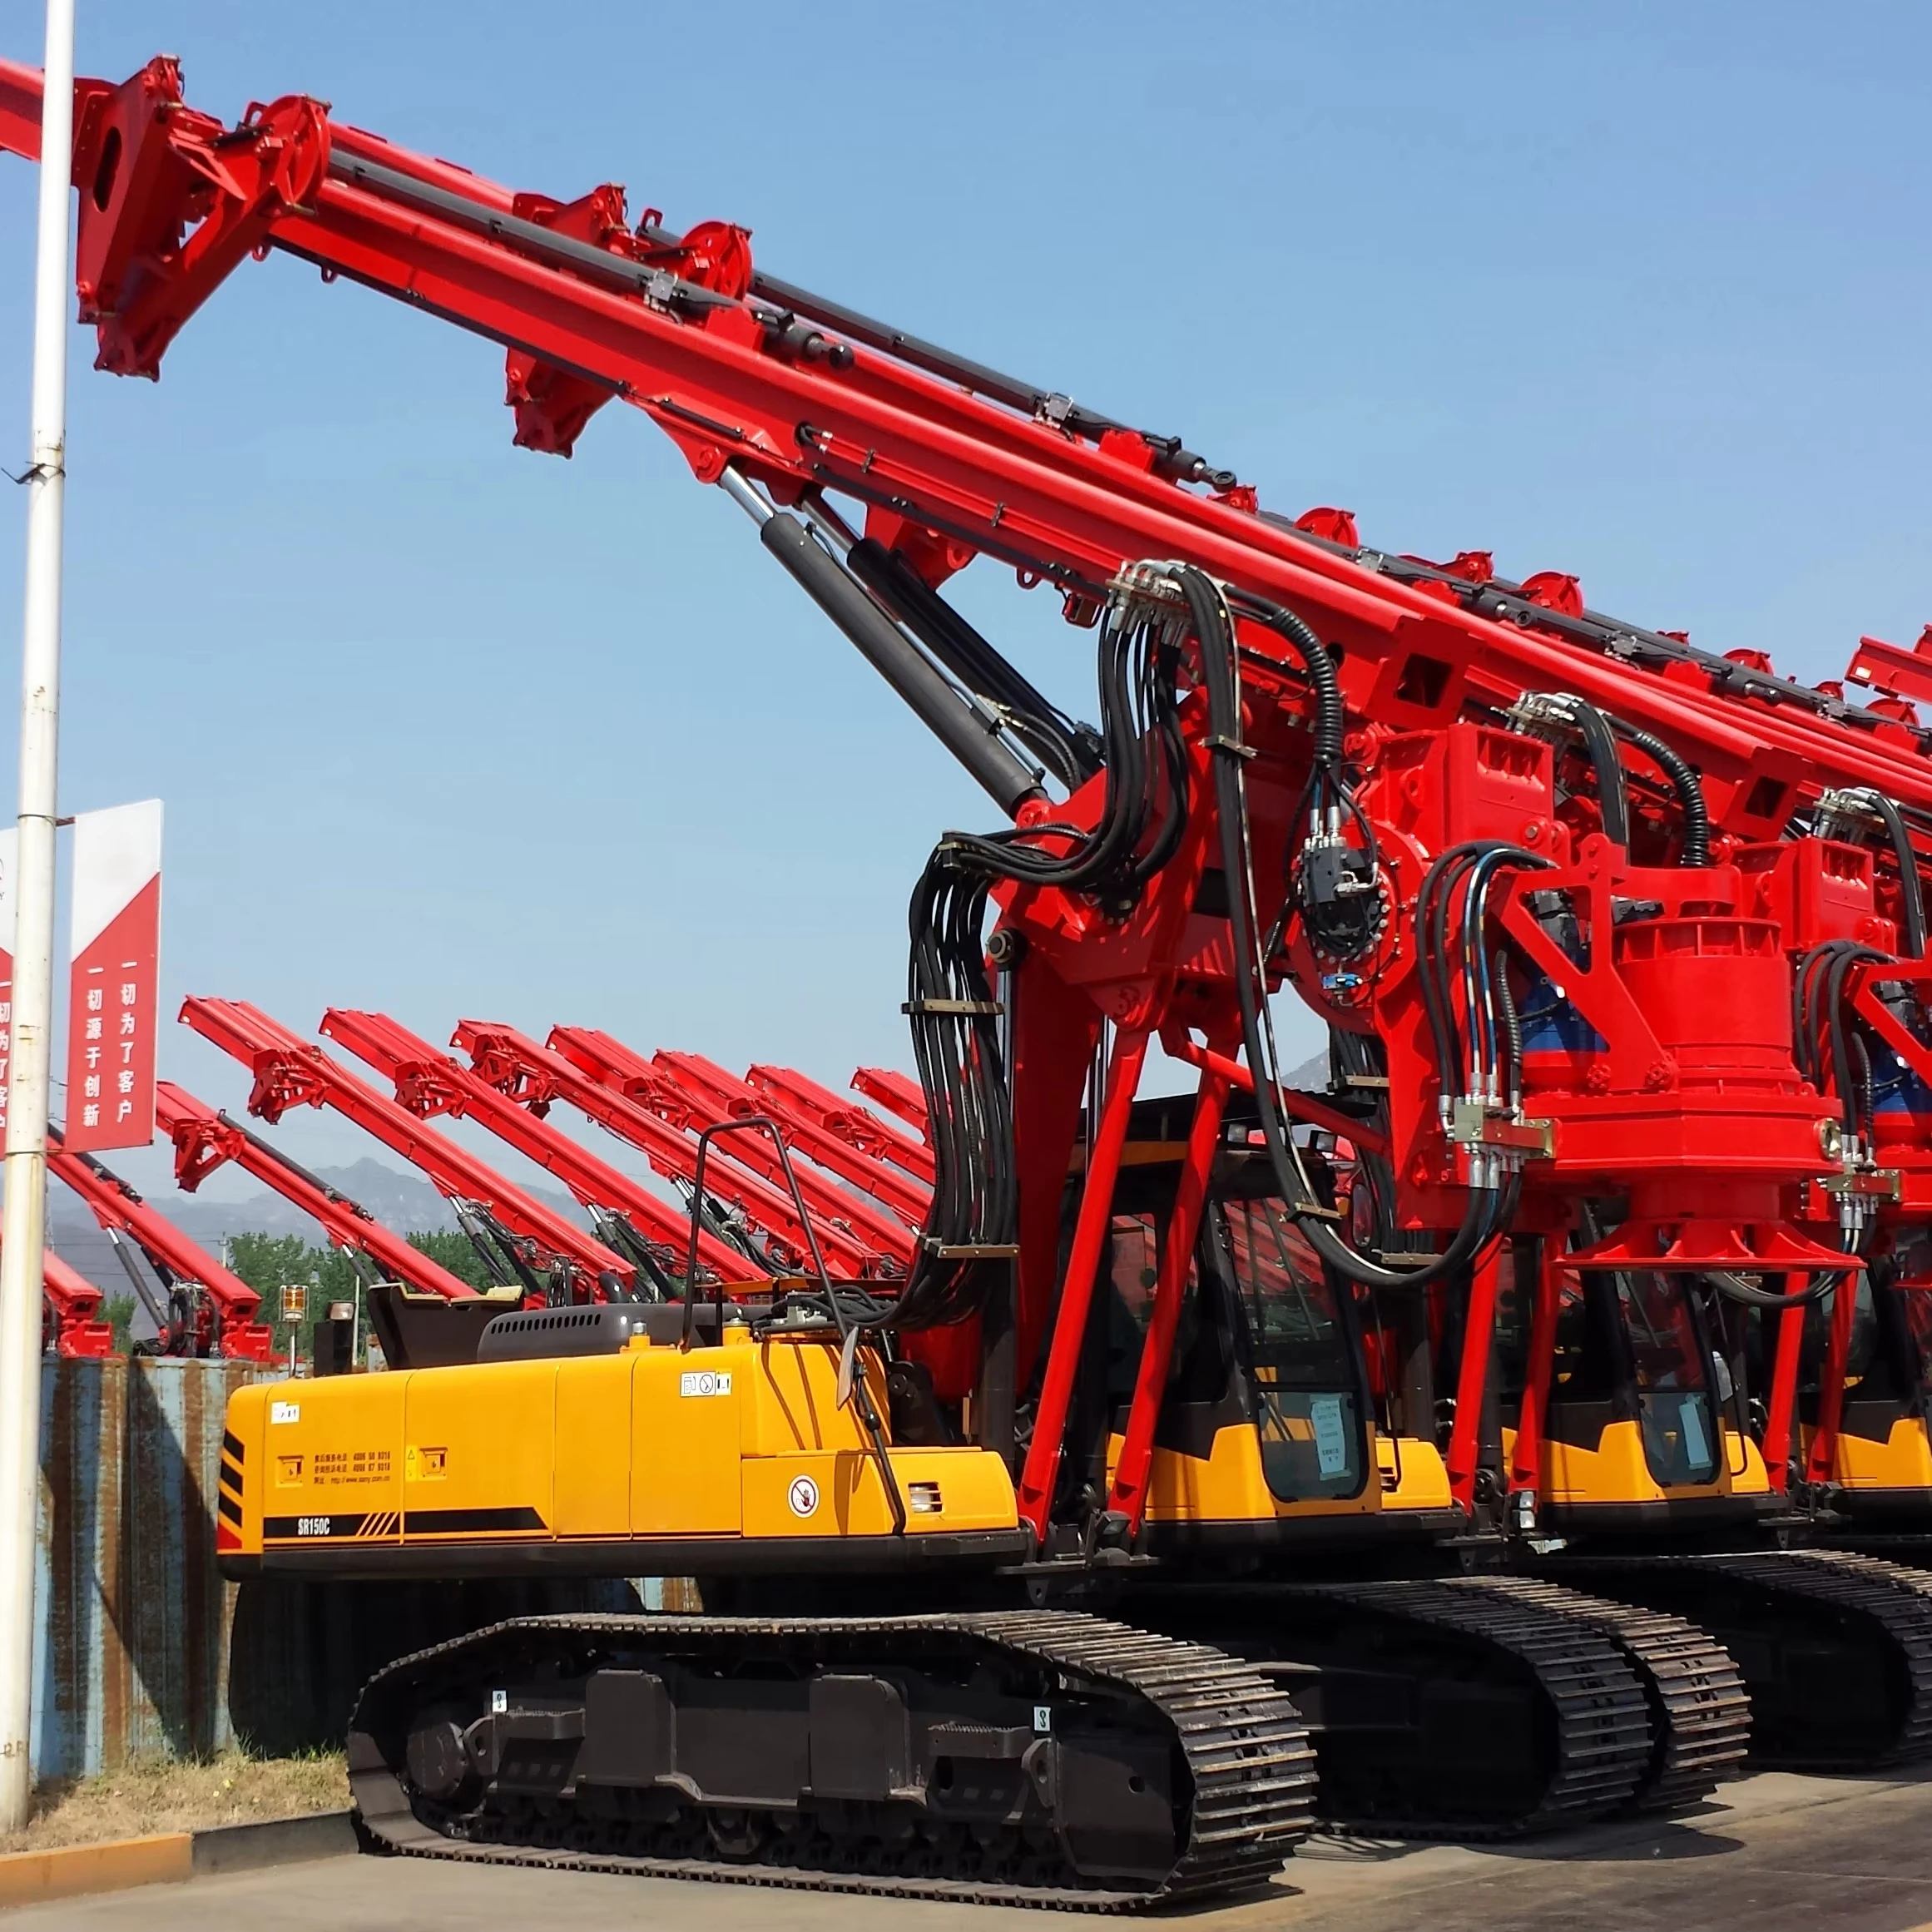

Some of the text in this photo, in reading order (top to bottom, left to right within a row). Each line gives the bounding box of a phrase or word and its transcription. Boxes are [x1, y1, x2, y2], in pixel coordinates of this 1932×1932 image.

[82, 966, 105, 1127] 一切源于创新
[116, 961, 138, 1123] 一切为了客户
[298, 1518, 330, 1536] SR150C
